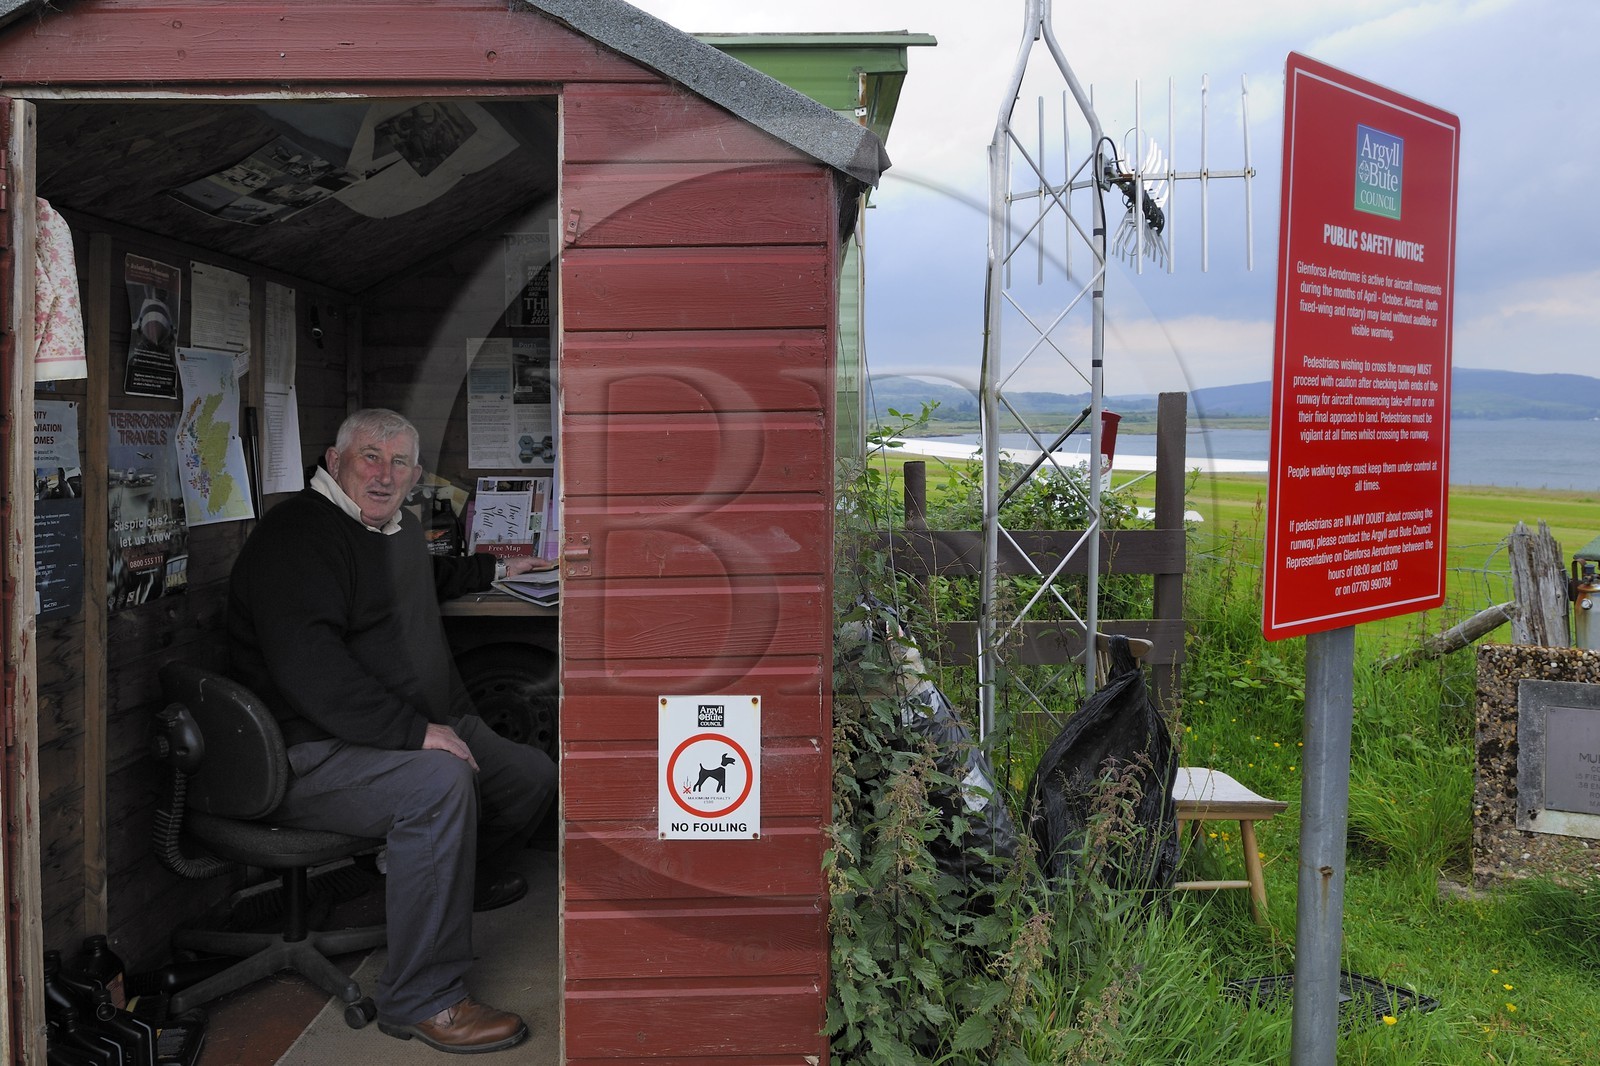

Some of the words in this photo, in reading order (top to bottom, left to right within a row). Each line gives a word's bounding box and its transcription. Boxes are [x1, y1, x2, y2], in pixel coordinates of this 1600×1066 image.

[1361, 133, 1399, 170] Argyll
[1369, 162, 1398, 192] Bute
[1360, 189, 1396, 211] COUNCIL
[1323, 224, 1358, 249] PUBLIC
[1361, 232, 1393, 256] SAFETY
[1395, 239, 1424, 262] NOTICE
[1297, 260, 1326, 277] Glenforsa
[1328, 266, 1360, 282] Aerodrome
[1368, 273, 1384, 286] active
[1394, 278, 1413, 290] aircraft
[1414, 282, 1442, 295] movements
[1300, 281, 1320, 297] during
[1322, 284, 1332, 296] the
[1334, 286, 1356, 300] months
[1364, 290, 1377, 303] April
[1404, 296, 1423, 308] Aircraft
[1425, 300, 1438, 312] (both
[1300, 300, 1332, 317] fixed-wing
[1334, 304, 1345, 316] and
[1347, 306, 1366, 320] rotary)
[1367, 312, 1379, 323] may
[1380, 310, 1392, 322] land
[1393, 312, 1412, 324] without
[1413, 314, 1431, 326] audible
[1352, 324, 1370, 336] visible
[1370, 328, 1394, 341] warning.
[1304, 355, 1339, 370] Pedestrians
[1341, 358, 1363, 374] wishing
[1372, 362, 1386, 372] cross
[1388, 362, 1396, 372] the
[1397, 364, 1416, 376] runway
[1417, 363, 1432, 374] MUST
[1293, 375, 1319, 388] proceed
[1320, 375, 1334, 387] with
[1335, 376, 1358, 388] caution
[1358, 377, 1372, 388] after
[1372, 378, 1397, 392] checking
[1398, 379, 1410, 390] both
[1411, 380, 1423, 390] ends
[1296, 394, 1320, 407] runway
[1322, 393, 1330, 404] for
[1332, 394, 1354, 405] aircraft
[1354, 395, 1390, 408] commencing
[1390, 396, 1412, 406] take-off
[1412, 398, 1420, 406] run
[109, 412, 176, 429] TERRORISM
[1298, 411, 1313, 422] their
[1314, 411, 1328, 422] final
[1330, 412, 1358, 424] approach
[1365, 412, 1379, 422] land.
[1380, 412, 1411, 422] Pedestrians
[1412, 413, 1425, 423] must
[118, 430, 168, 446] TRAVELS
[1300, 428, 1323, 443] vigilant
[1341, 428, 1357, 440] times
[1358, 429, 1376, 440] whilst
[1376, 429, 1400, 442] crossing
[1400, 429, 1408, 440] the
[1410, 430, 1429, 442] runway.
[1288, 466, 1310, 479] People
[1311, 465, 1335, 478] walking
[1336, 464, 1351, 477] dogs
[1352, 464, 1366, 474] must
[1368, 464, 1380, 475] keep
[1382, 463, 1396, 473] them
[1398, 462, 1413, 472] under
[1414, 461, 1430, 471] control
[1363, 480, 1380, 490] times.
[1296, 518, 1332, 534] pedestrians
[1334, 518, 1343, 528] are
[1352, 513, 1365, 525] ANY
[1366, 512, 1385, 524] DOUBT
[1386, 510, 1400, 522] about
[1402, 509, 1424, 521] crossing
[120, 536, 132, 548] let
[134, 536, 146, 545] us
[148, 532, 171, 542] know
[1290, 538, 1315, 551] runway,
[1316, 535, 1336, 549] please
[1338, 532, 1360, 544] contact
[1361, 530, 1370, 540] the
[1371, 528, 1387, 542] Argyll
[1388, 527, 1398, 538] and
[1400, 525, 1412, 536] Bute
[1412, 523, 1431, 535] Council
[130, 560, 144, 568] 0800
[1286, 552, 1332, 570] Representative
[1334, 552, 1342, 562] on
[1343, 548, 1370, 560] Glenforsa
[1371, 545, 1400, 557] Aerodrome
[1402, 542, 1424, 553] between
[1328, 569, 1345, 580] hours
[1371, 562, 1382, 574] and
[1383, 560, 1398, 572] 18:00
[700, 706, 723, 716] Argyll
[672, 823, 689, 832] NO
[694, 822, 747, 832] FOULING
